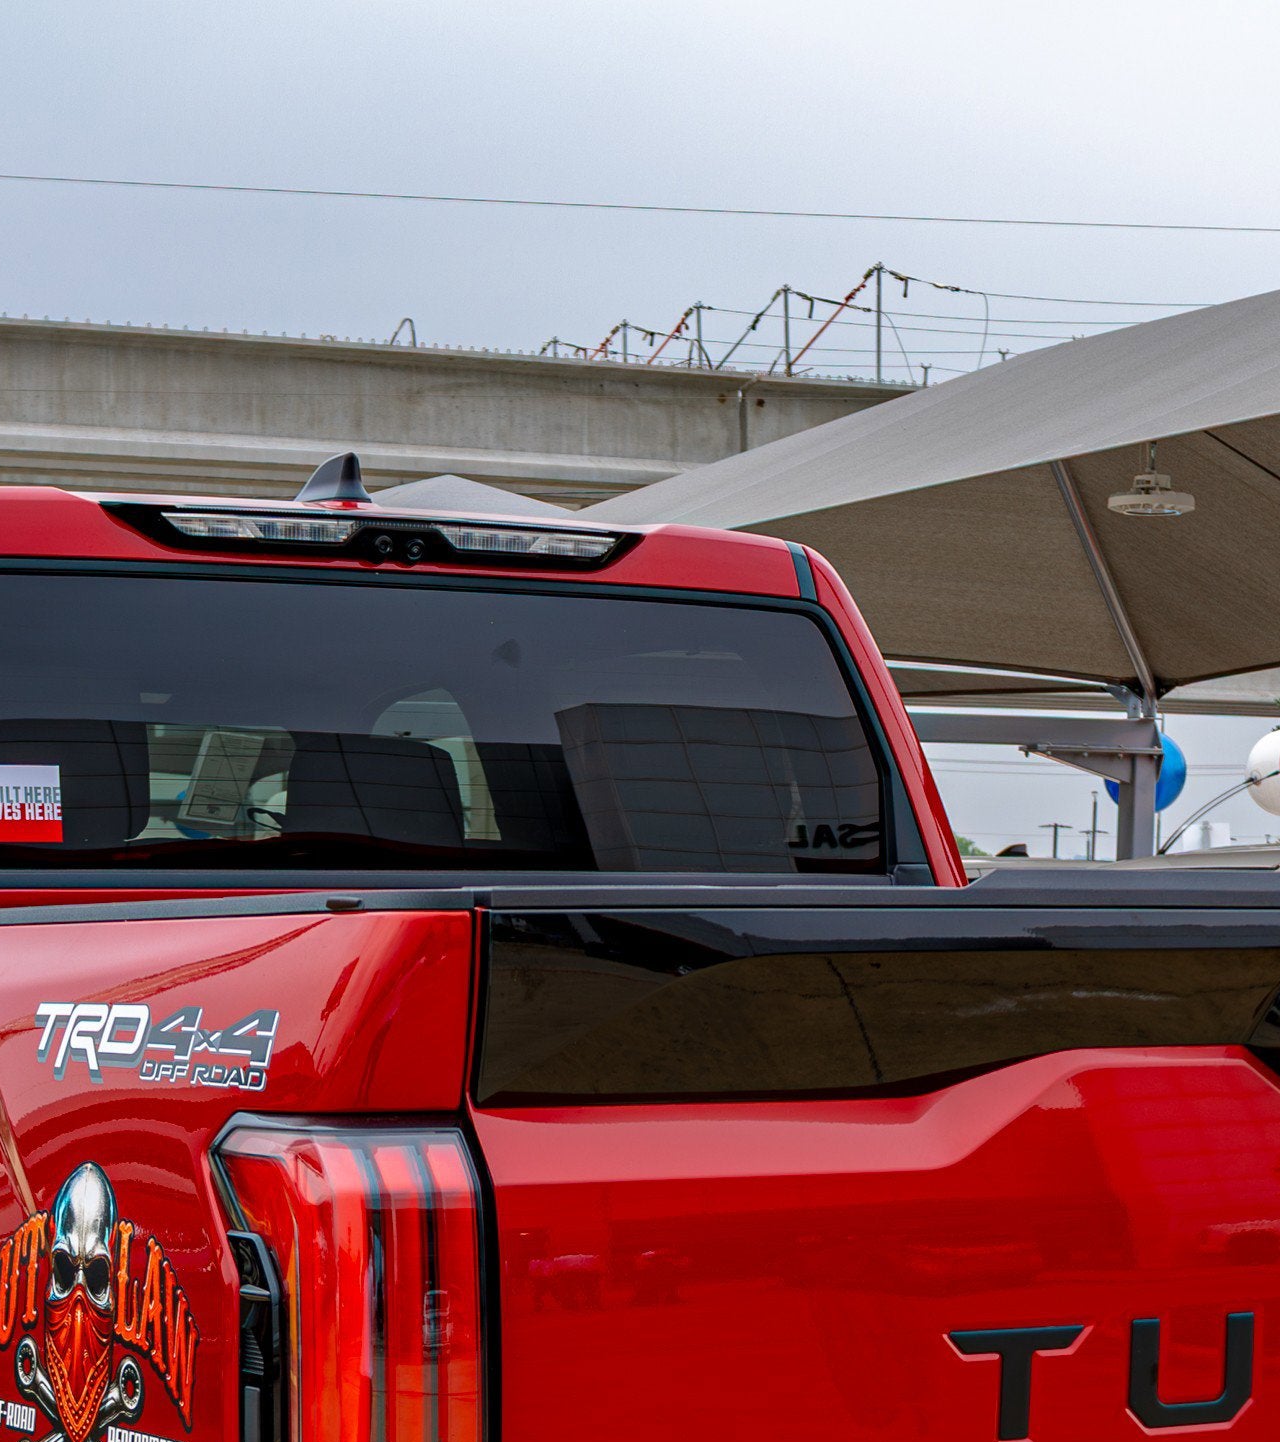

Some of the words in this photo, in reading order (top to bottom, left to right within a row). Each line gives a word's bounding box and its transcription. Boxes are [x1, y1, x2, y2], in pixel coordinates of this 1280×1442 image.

[24, 786, 61, 804] HERE
[25, 803, 63, 821] HERE
[35, 1001, 152, 1084] TRD
[146, 1006, 280, 1069] 4x4
[138, 1059, 190, 1083] OFF
[190, 1065, 268, 1092] ROAD
